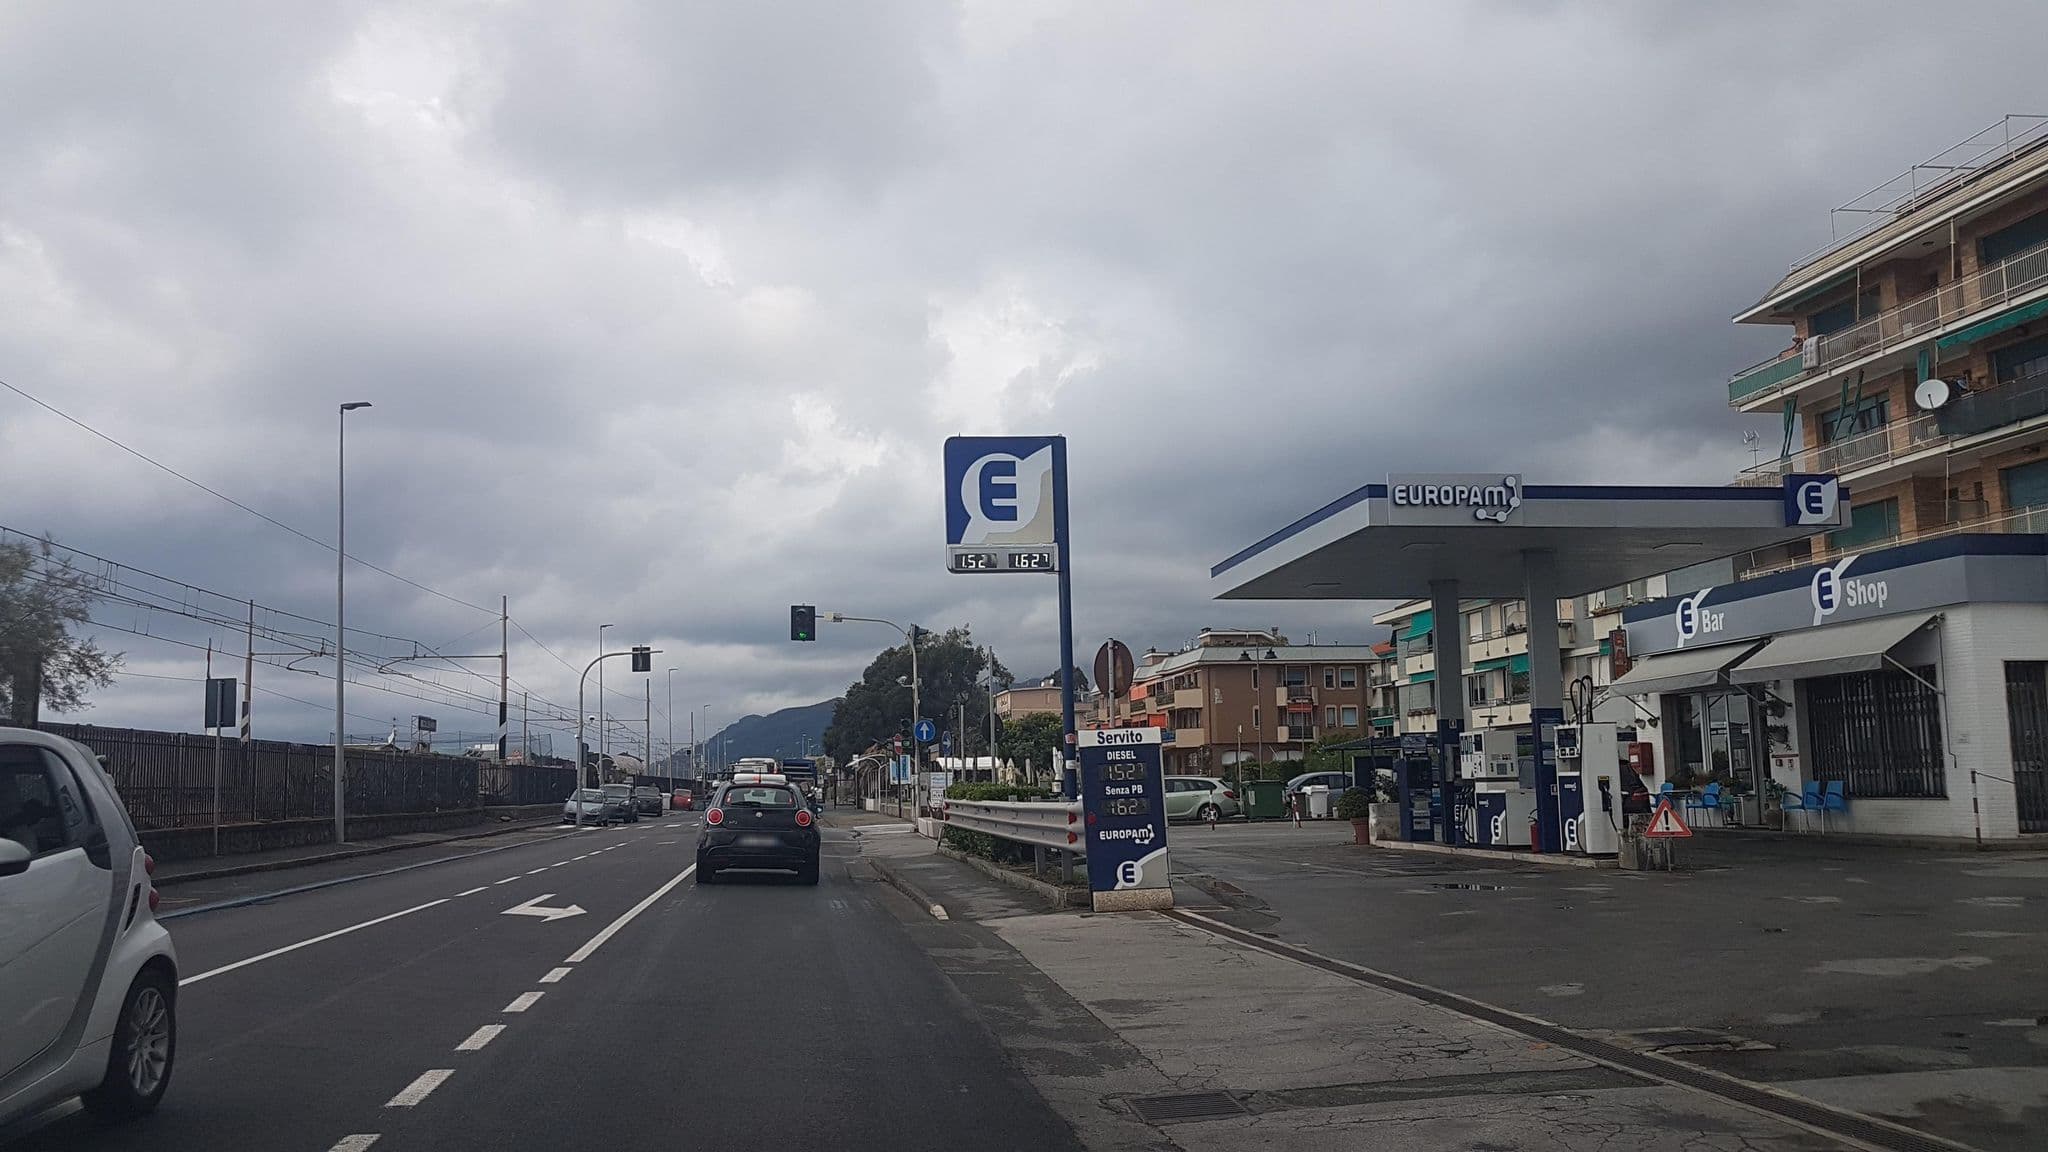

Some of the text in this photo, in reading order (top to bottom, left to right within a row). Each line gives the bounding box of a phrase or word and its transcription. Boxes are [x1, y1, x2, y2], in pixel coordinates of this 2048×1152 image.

[979, 461, 1017, 521] E
[1394, 485, 1507, 506] EUROPAM
[1805, 485, 1824, 514] E
[1818, 571, 1888, 609] E Shop
[1681, 601, 1725, 634] E Bar
[1097, 731, 1143, 745] Servito
[1107, 750, 1137, 760] DIESEL
[1105, 784, 1143, 795] Senza PB
[1122, 864, 1135, 883] E
